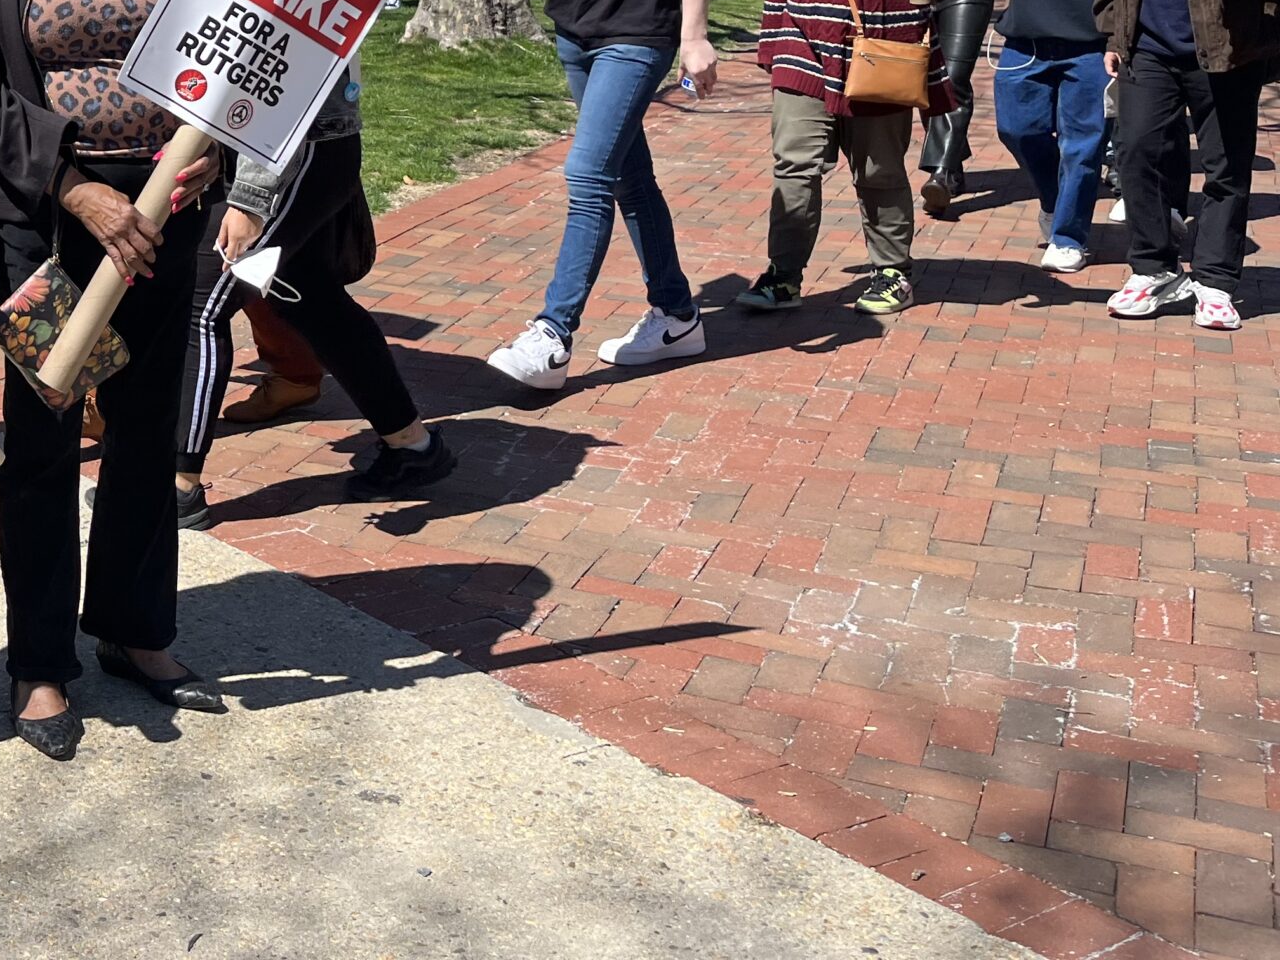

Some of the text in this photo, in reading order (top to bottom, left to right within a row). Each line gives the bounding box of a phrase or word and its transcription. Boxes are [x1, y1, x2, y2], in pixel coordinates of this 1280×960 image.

[197, 15, 289, 83] BETTER
[222, 1, 291, 56] FOR A
[175, 31, 284, 107] RUTGERS
